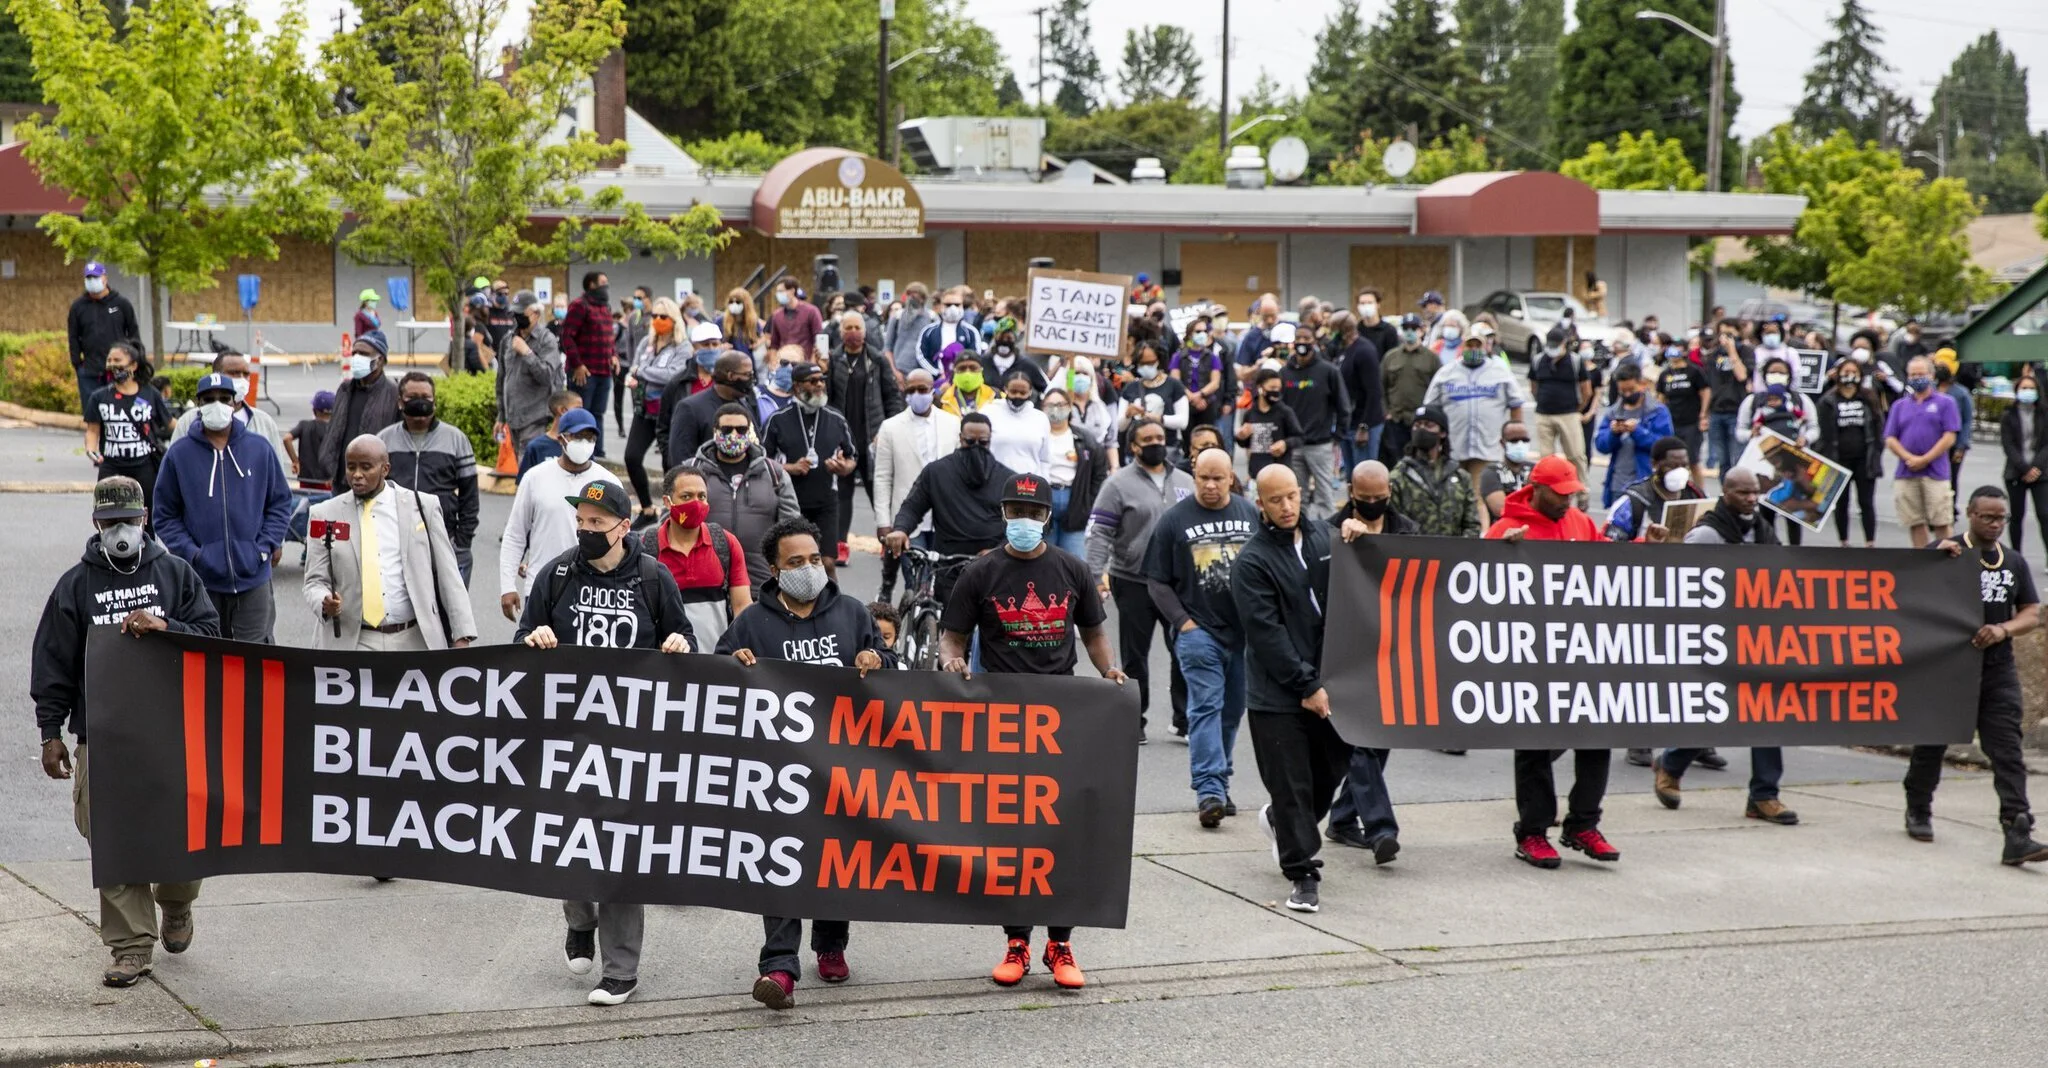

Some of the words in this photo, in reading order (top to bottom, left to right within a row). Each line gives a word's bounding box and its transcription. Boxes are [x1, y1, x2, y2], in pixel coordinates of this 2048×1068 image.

[801, 187, 906, 207] ABU-BAKR
[1040, 287, 1116, 307] STAND
[1034, 324, 1116, 349] RACISM!!
[98, 403, 153, 422] BLACK
[105, 424, 138, 439] LIVES
[94, 590, 114, 604] WE
[580, 585, 635, 610] CHOOSE
[1448, 562, 1536, 604] OUR
[1543, 564, 1726, 608] FAMILIES
[1736, 568, 1897, 609] MATTER
[105, 600, 126, 612] y'all
[128, 595, 152, 607] mad.
[92, 614, 112, 625] WE
[572, 610, 638, 650] 180
[783, 634, 839, 661] CHOOSE
[1449, 620, 1538, 663] OUR
[1546, 623, 1727, 665] FAMILIES
[1737, 625, 1901, 665] MATTER
[316, 667, 526, 718] BLACK
[544, 674, 816, 742] FATHERS
[829, 697, 1062, 754] MATTER
[1452, 681, 1541, 723] OUR
[1549, 682, 1729, 723] FAMILIES
[1738, 682, 1897, 722] MATTER
[314, 725, 525, 785] BLACK
[540, 740, 812, 814] FATHERS
[825, 767, 1060, 824] MATTER
[312, 795, 521, 859] BLACK
[531, 812, 804, 886] FATHERS
[818, 839, 1055, 895] MATTER
